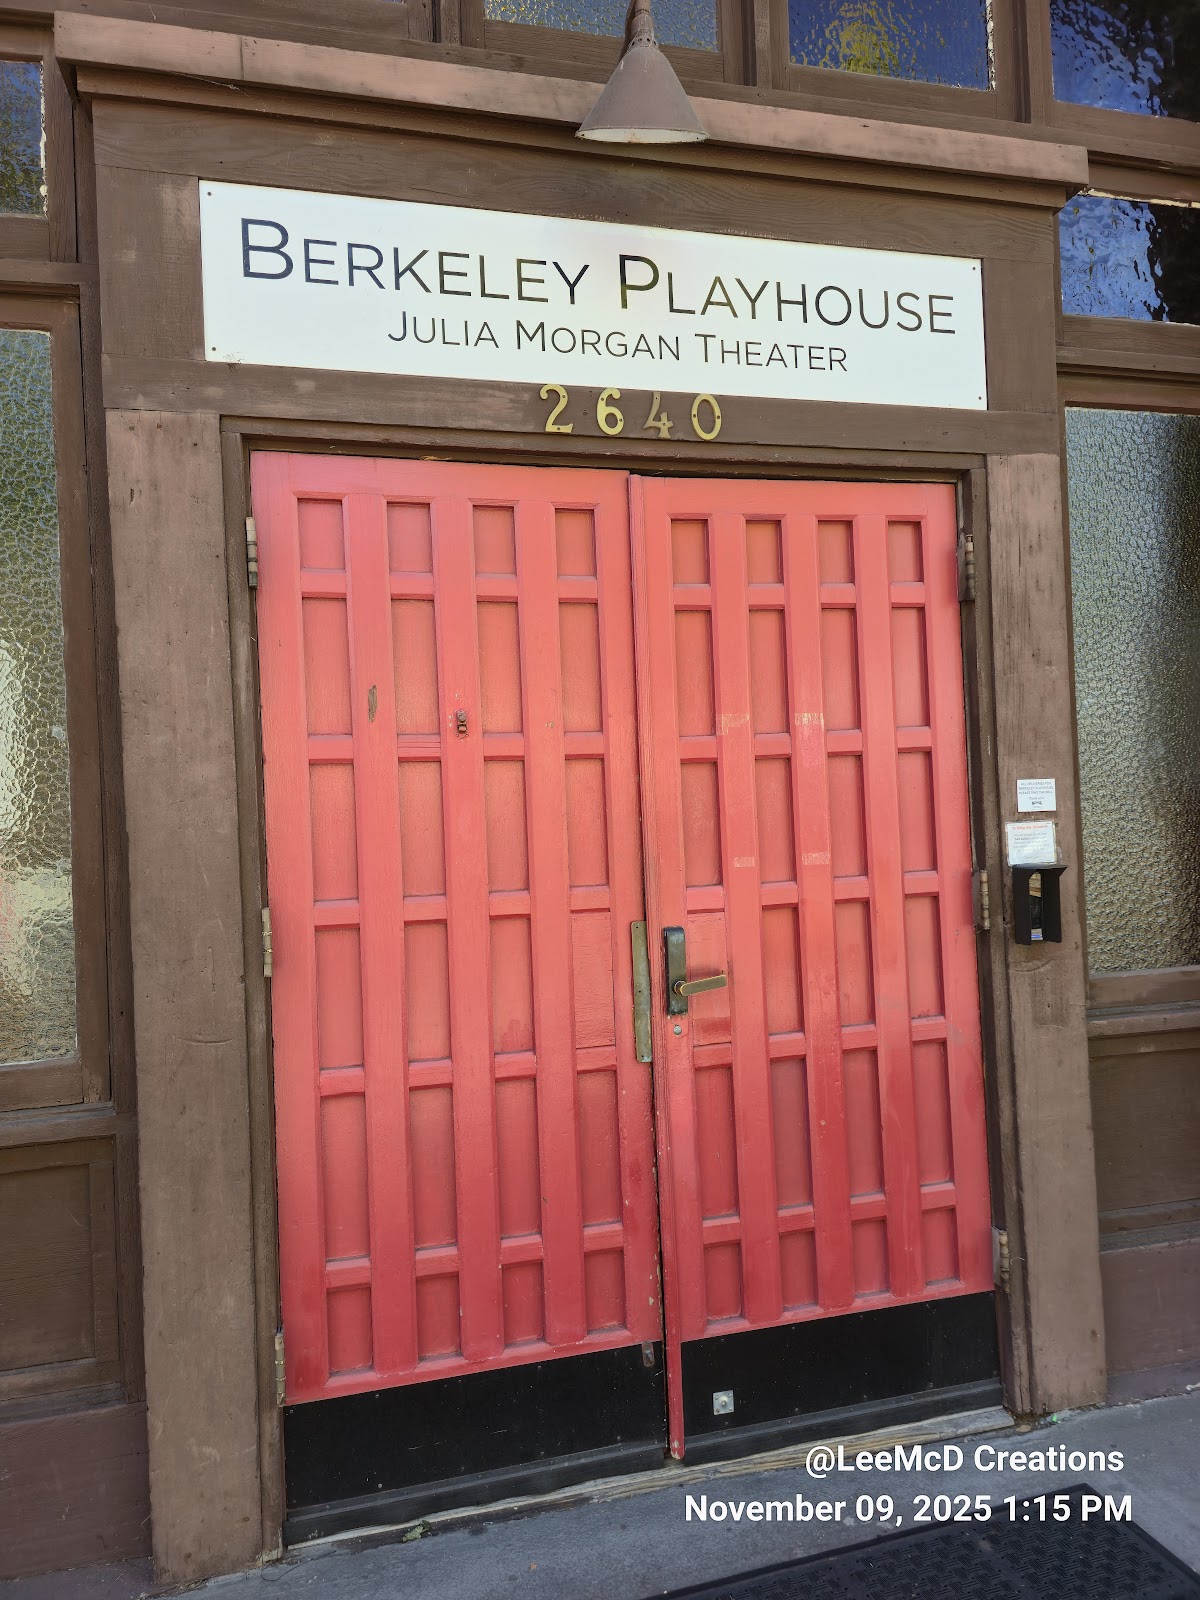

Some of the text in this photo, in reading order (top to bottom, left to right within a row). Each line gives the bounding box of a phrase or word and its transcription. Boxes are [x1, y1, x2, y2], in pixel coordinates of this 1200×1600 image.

[240, 217, 956, 335] BERKELEY PLAYHOUSE
[388, 311, 848, 373] JULIA MORGAN THEATER
[539, 384, 722, 441] 2640
